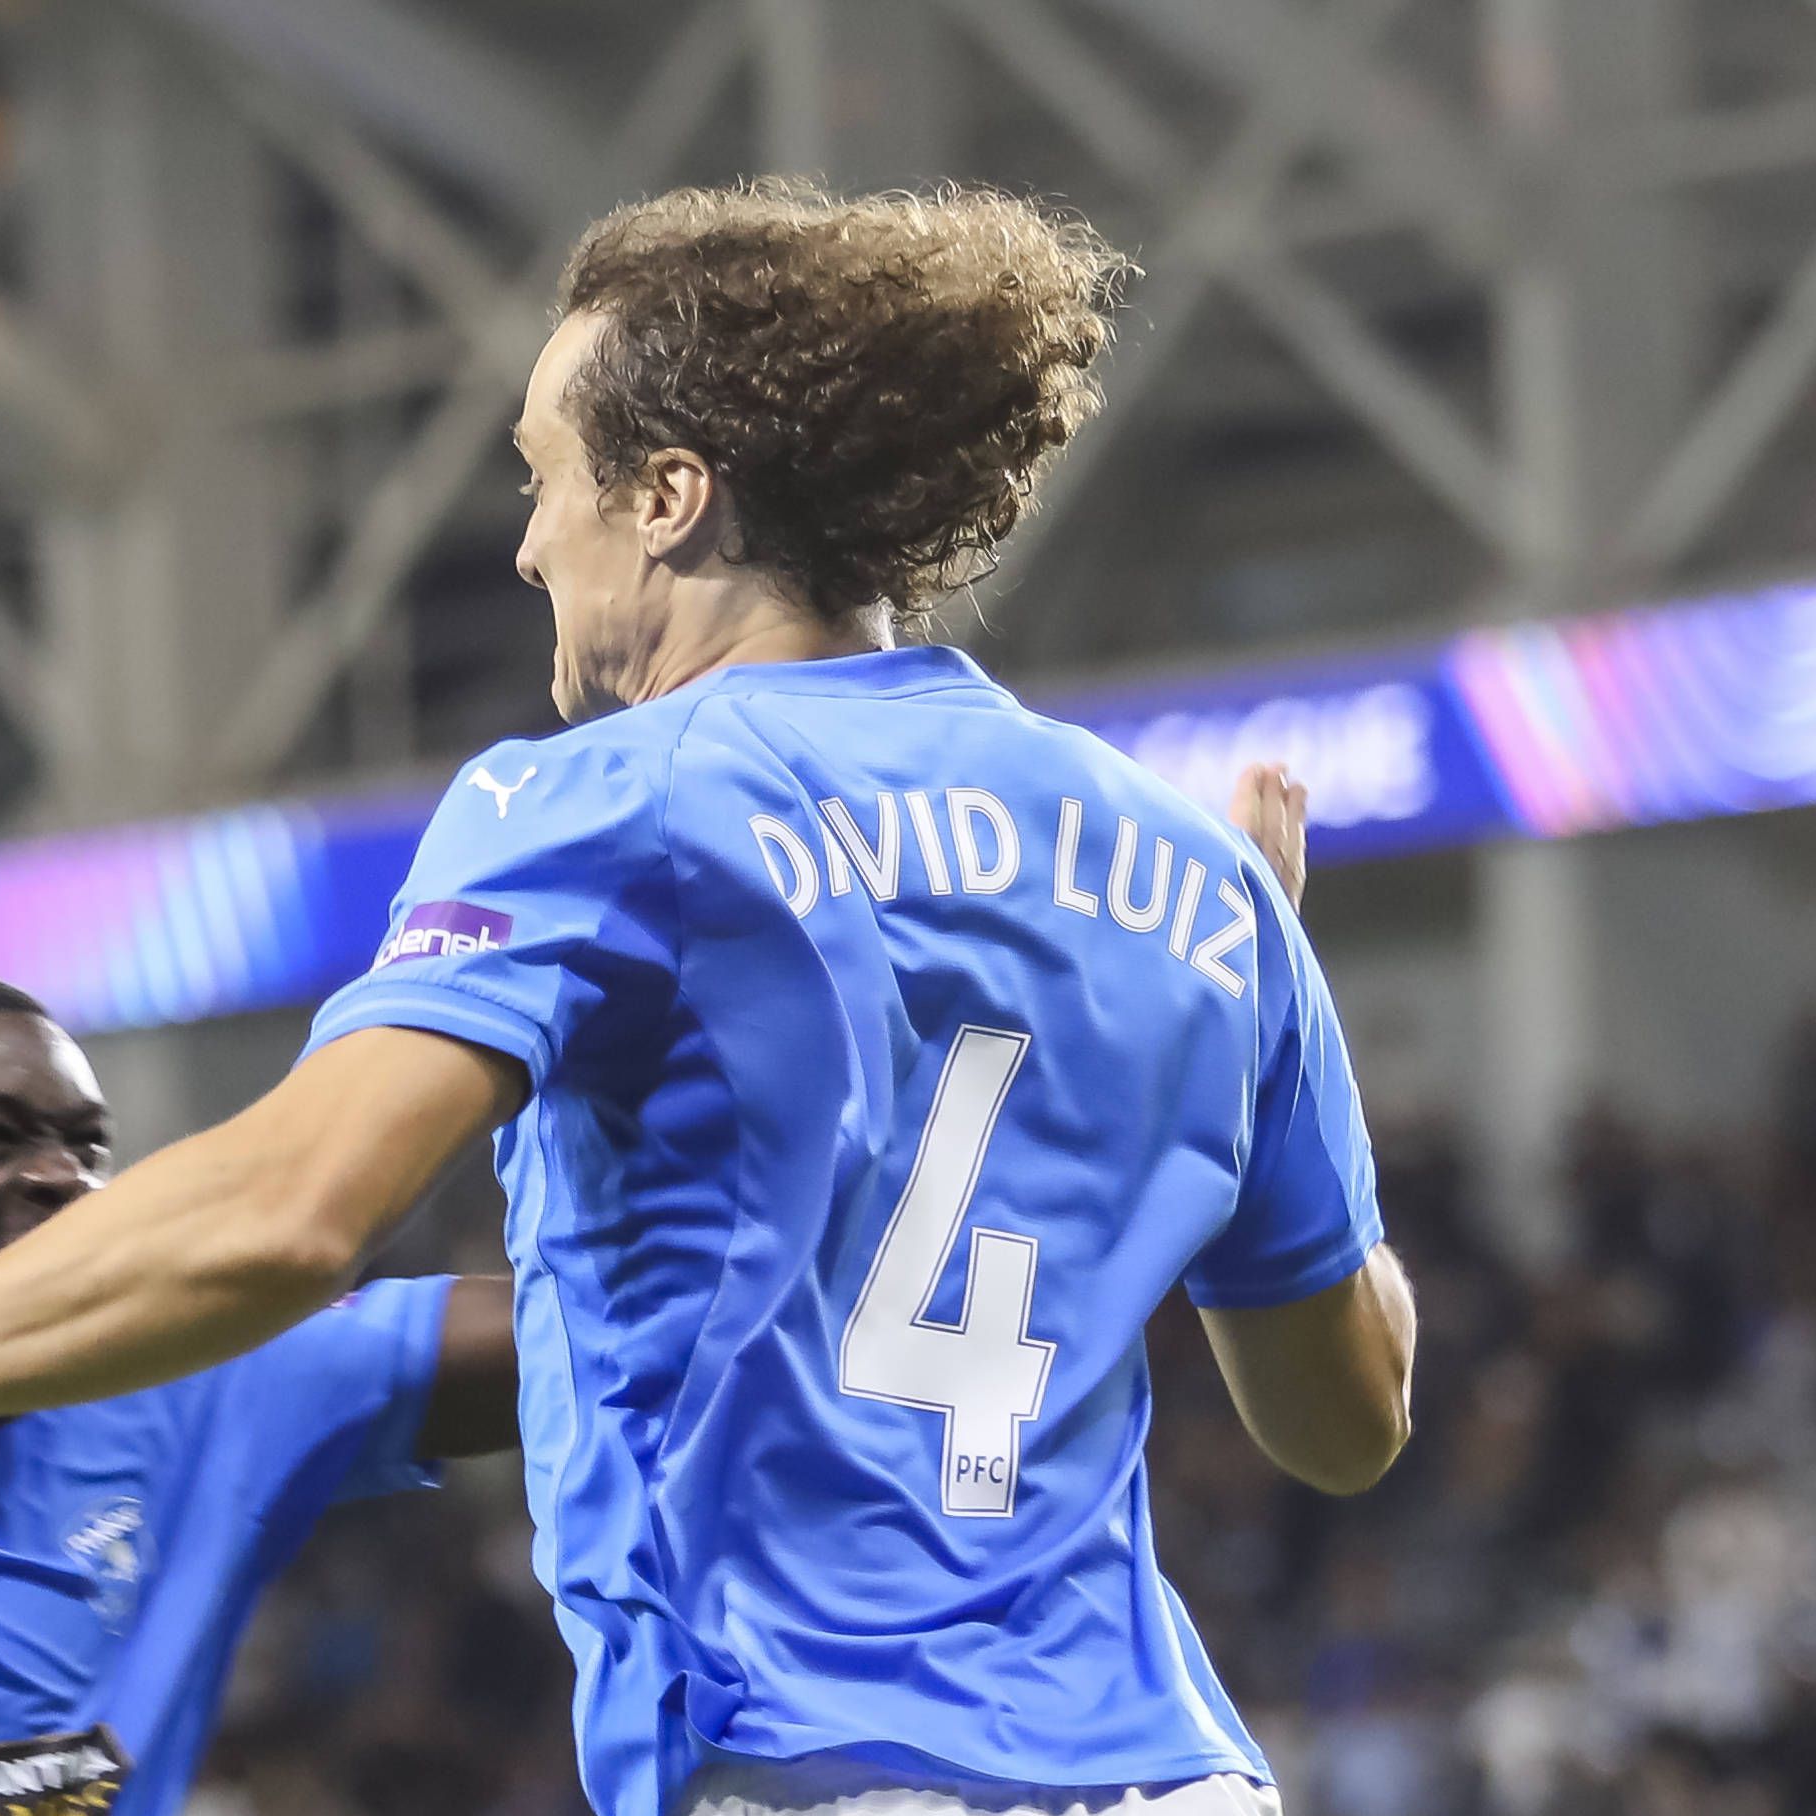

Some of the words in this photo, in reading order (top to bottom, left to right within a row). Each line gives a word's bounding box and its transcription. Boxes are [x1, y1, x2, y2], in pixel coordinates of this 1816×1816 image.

[1053, 796, 1257, 1000] LUIZ
[840, 1023, 1057, 1518] 4
[955, 1454, 1005, 1484] PFC
